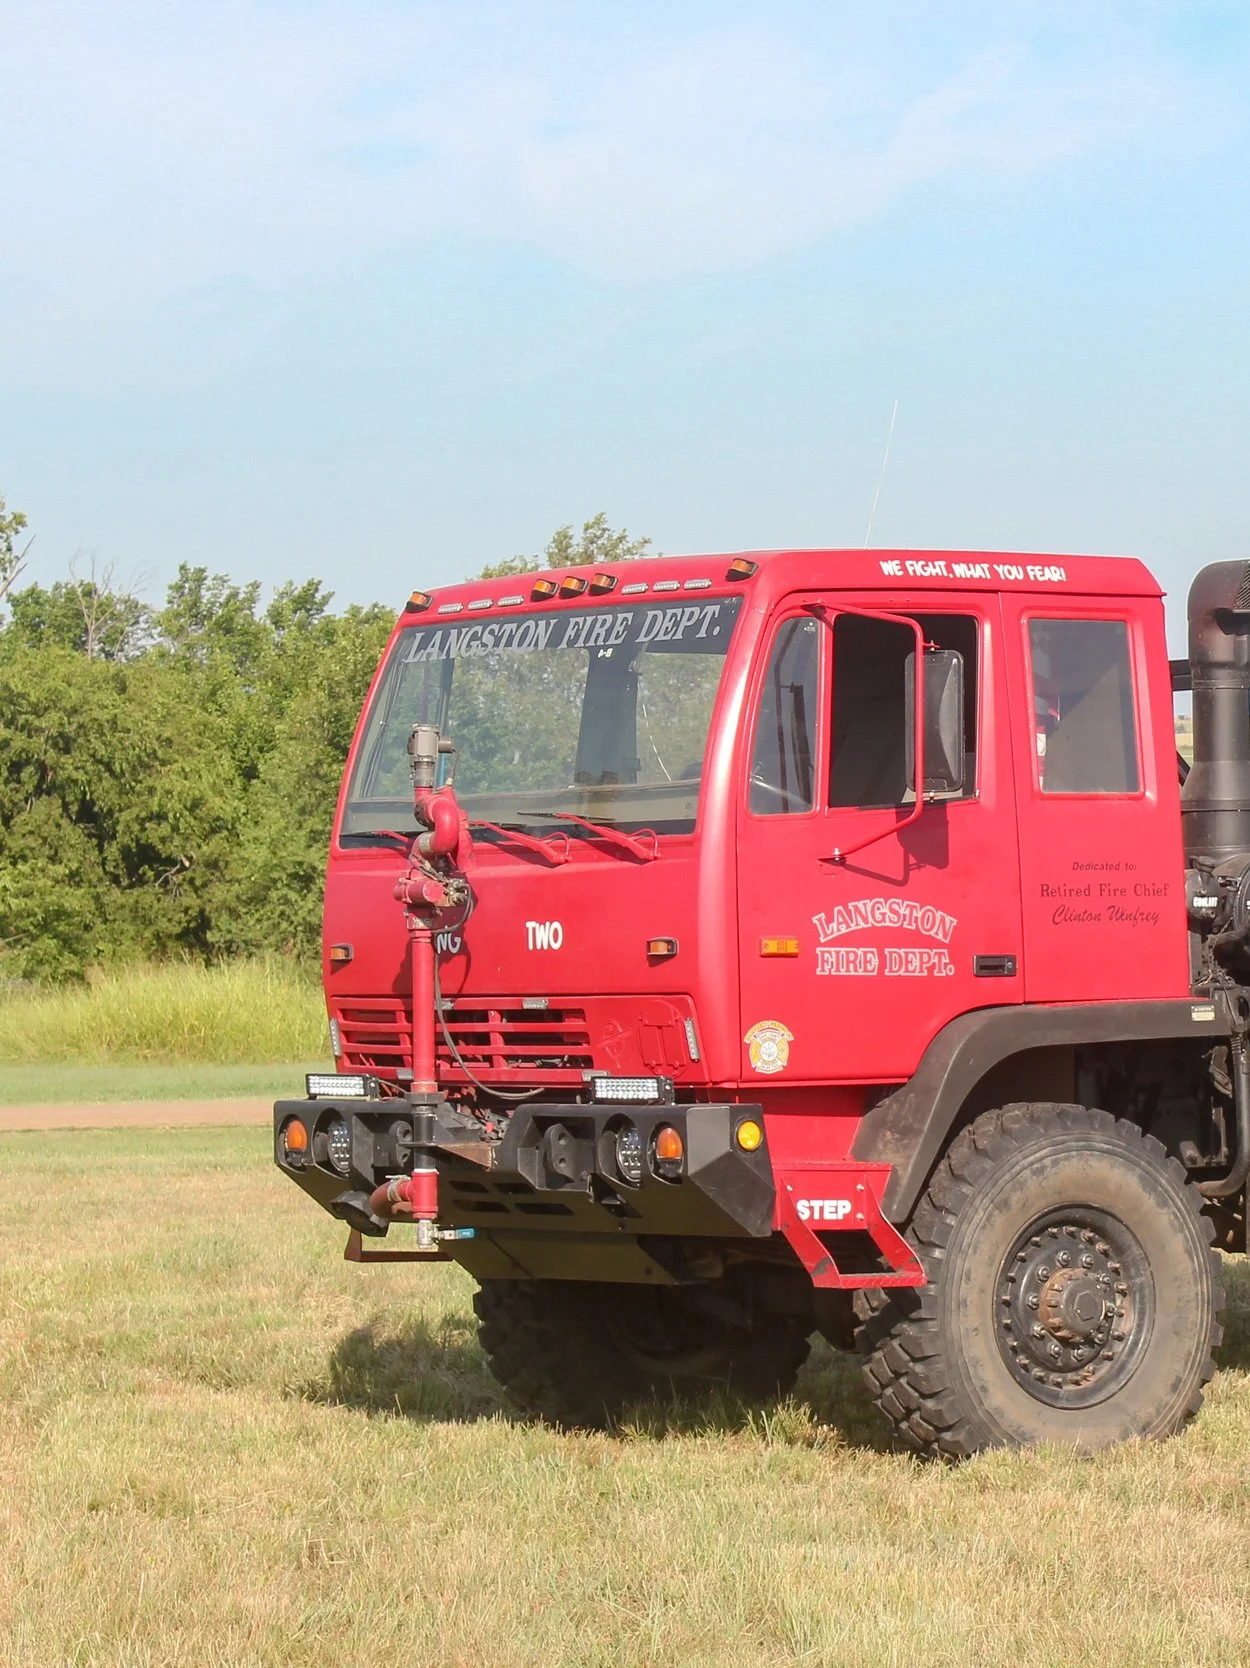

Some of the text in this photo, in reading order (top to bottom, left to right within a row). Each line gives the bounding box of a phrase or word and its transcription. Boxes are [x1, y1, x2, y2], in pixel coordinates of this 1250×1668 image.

[879, 560, 904, 576] WE
[951, 562, 991, 579] WHAT
[993, 563, 1024, 580] YOU
[1026, 565, 1067, 582] FEAR!
[402, 604, 721, 664] LANGSTON FIRE DEPT.
[1072, 861, 1137, 871] Dedicated to:
[1040, 882, 1170, 898] Retired Fire Chief
[812, 898, 957, 943] LANGSTON
[1052, 904, 1101, 926] Clinton
[525, 920, 564, 950] TWO
[815, 947, 955, 976] FIRE DEPT.
[796, 1199, 852, 1220] STEP
